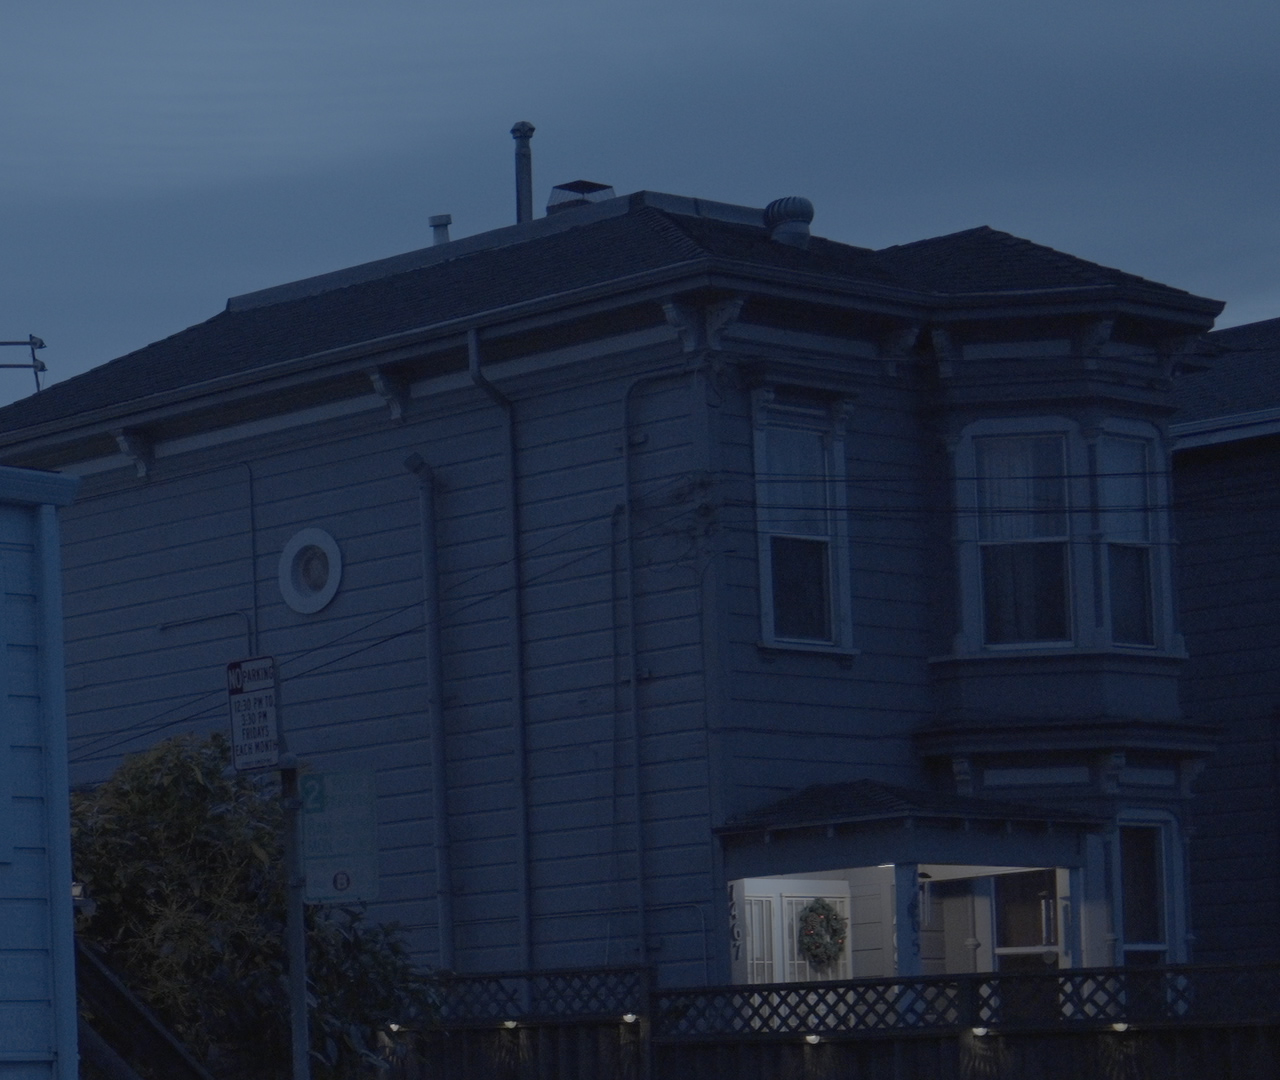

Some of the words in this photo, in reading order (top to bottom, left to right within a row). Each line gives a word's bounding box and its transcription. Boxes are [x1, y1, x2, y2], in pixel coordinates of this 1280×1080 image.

[228, 667, 243, 691] NO
[243, 666, 275, 684] PARKING
[253, 696, 264, 711] PM
[265, 694, 274, 709] TO
[258, 710, 268, 724] PM
